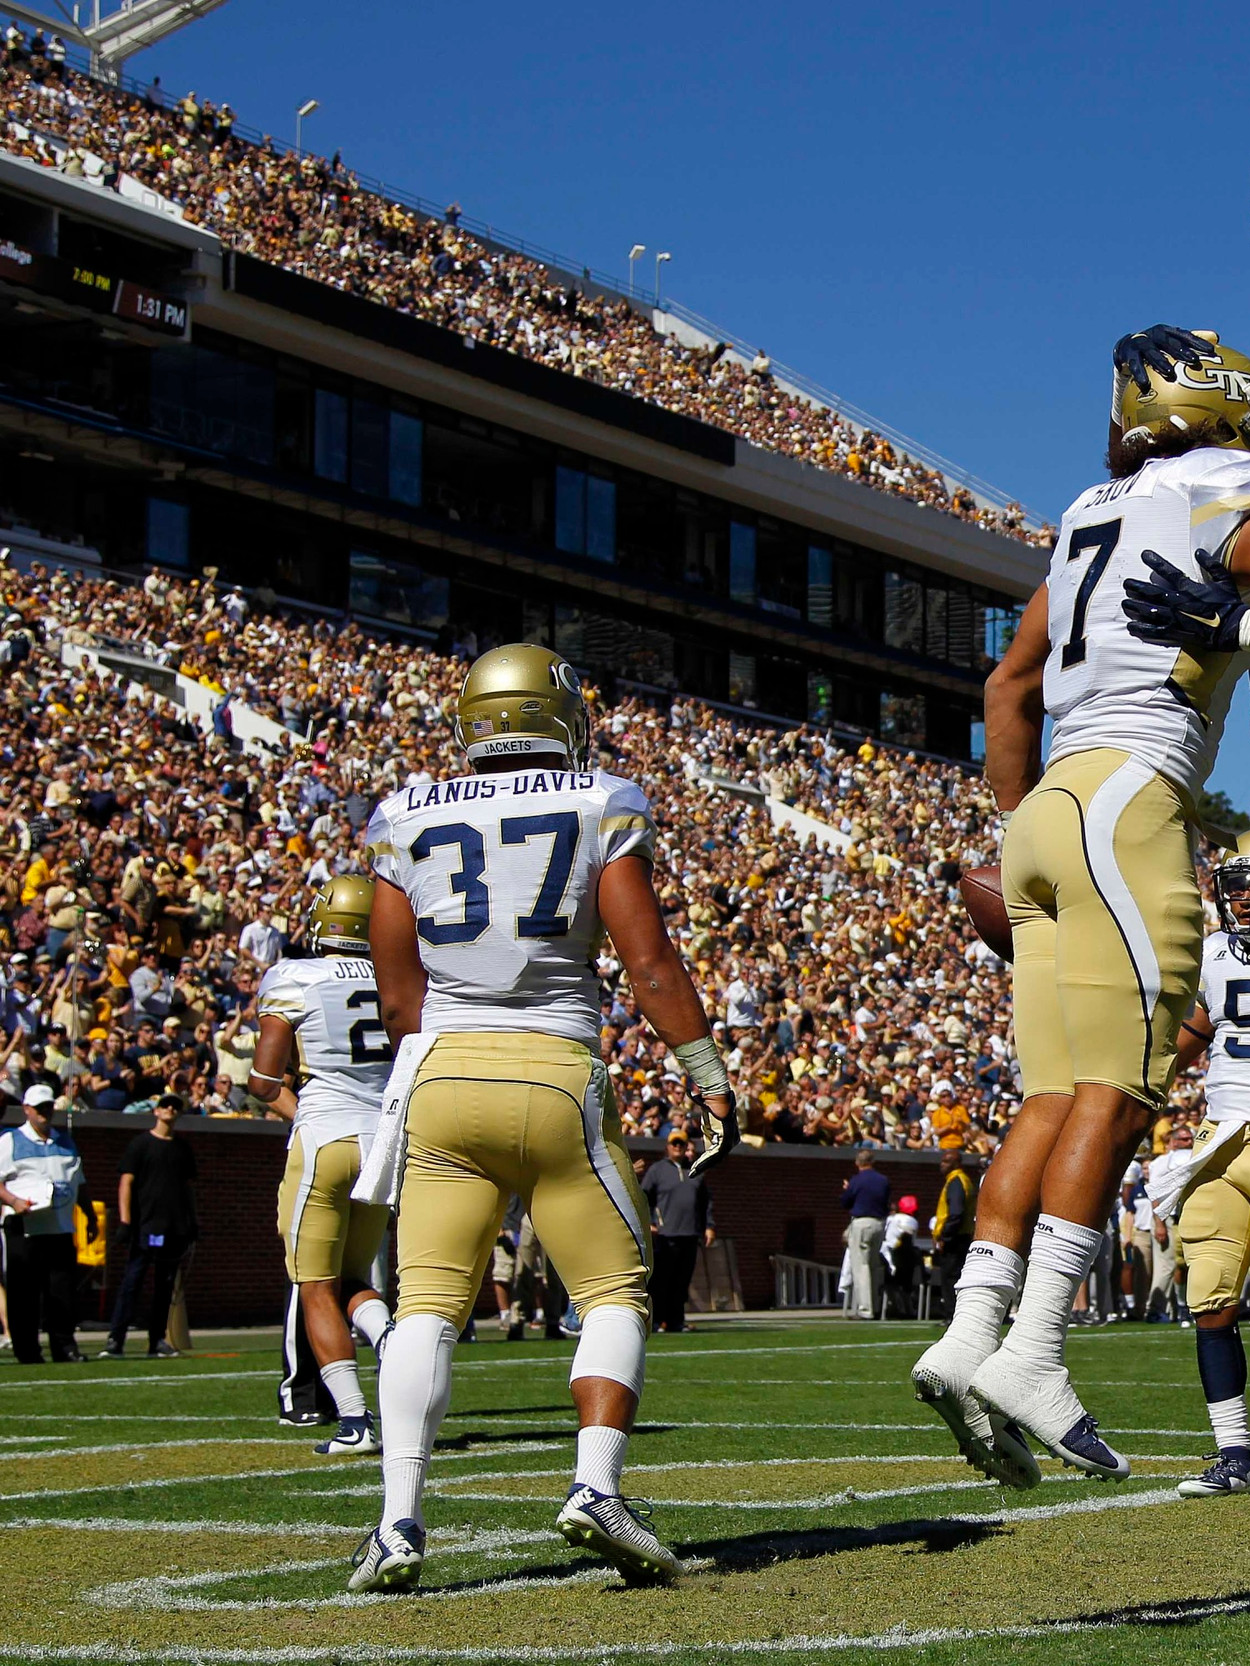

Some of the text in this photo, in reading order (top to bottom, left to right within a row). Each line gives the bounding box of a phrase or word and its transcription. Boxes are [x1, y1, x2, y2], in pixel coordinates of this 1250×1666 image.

[137, 294, 186, 328] 1:31 PM
[1060, 515, 1125, 673] 7
[500, 720, 510, 732] 37
[484, 739, 532, 755] JACKETS
[408, 808, 583, 948] 37
